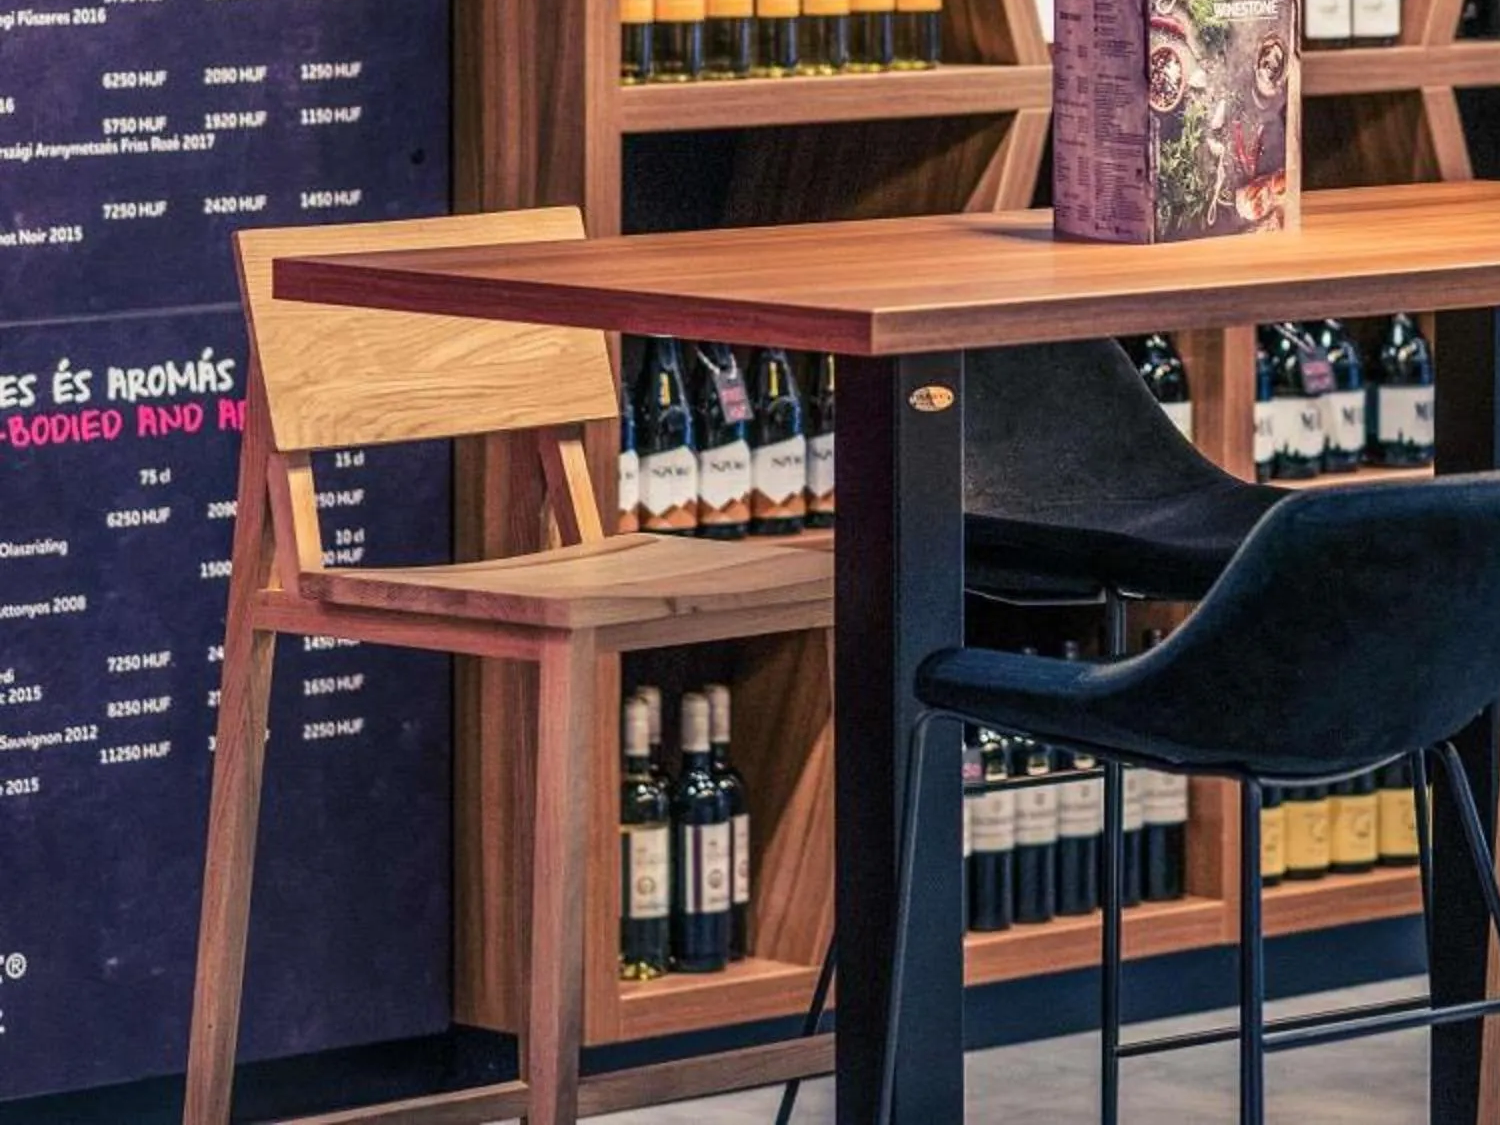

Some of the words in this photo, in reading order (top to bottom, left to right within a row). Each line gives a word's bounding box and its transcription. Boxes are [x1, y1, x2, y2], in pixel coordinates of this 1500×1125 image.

[72, 7, 107, 25] 2016
[138, 70, 167, 87] HUF
[239, 65, 267, 83] HUF
[334, 61, 362, 78] HUF
[138, 115, 167, 132] HUF
[238, 110, 267, 127] HUF
[333, 106, 362, 123] HUF
[182, 132, 216, 151] 2017
[138, 200, 167, 217] HUF
[238, 194, 267, 212] HUF
[333, 189, 361, 206] HUF
[18, 228, 47, 245] Noir
[48, 225, 83, 244] 2015
[0, 373, 37, 409] ES
[52, 358, 93, 404] ÉS
[107, 346, 235, 403] AROMÁS
[137, 403, 203, 436] AND
[139, 468, 158, 485] 75
[335, 451, 352, 468] 15
[106, 509, 141, 528] 6250
[141, 506, 171, 524] HUF
[336, 488, 364, 506] HUF
[336, 546, 364, 564] HUF
[107, 654, 141, 672] 7250
[142, 650, 171, 668] HUF
[8, 685, 43, 704] 2015
[107, 699, 142, 718] 8250
[142, 695, 172, 713] HUF
[336, 673, 364, 691] HUF
[64, 724, 98, 743] 2012
[99, 744, 141, 765] 11250
[142, 740, 171, 759] HUF
[336, 717, 364, 735] HUF
[5, 776, 40, 796] 2015
